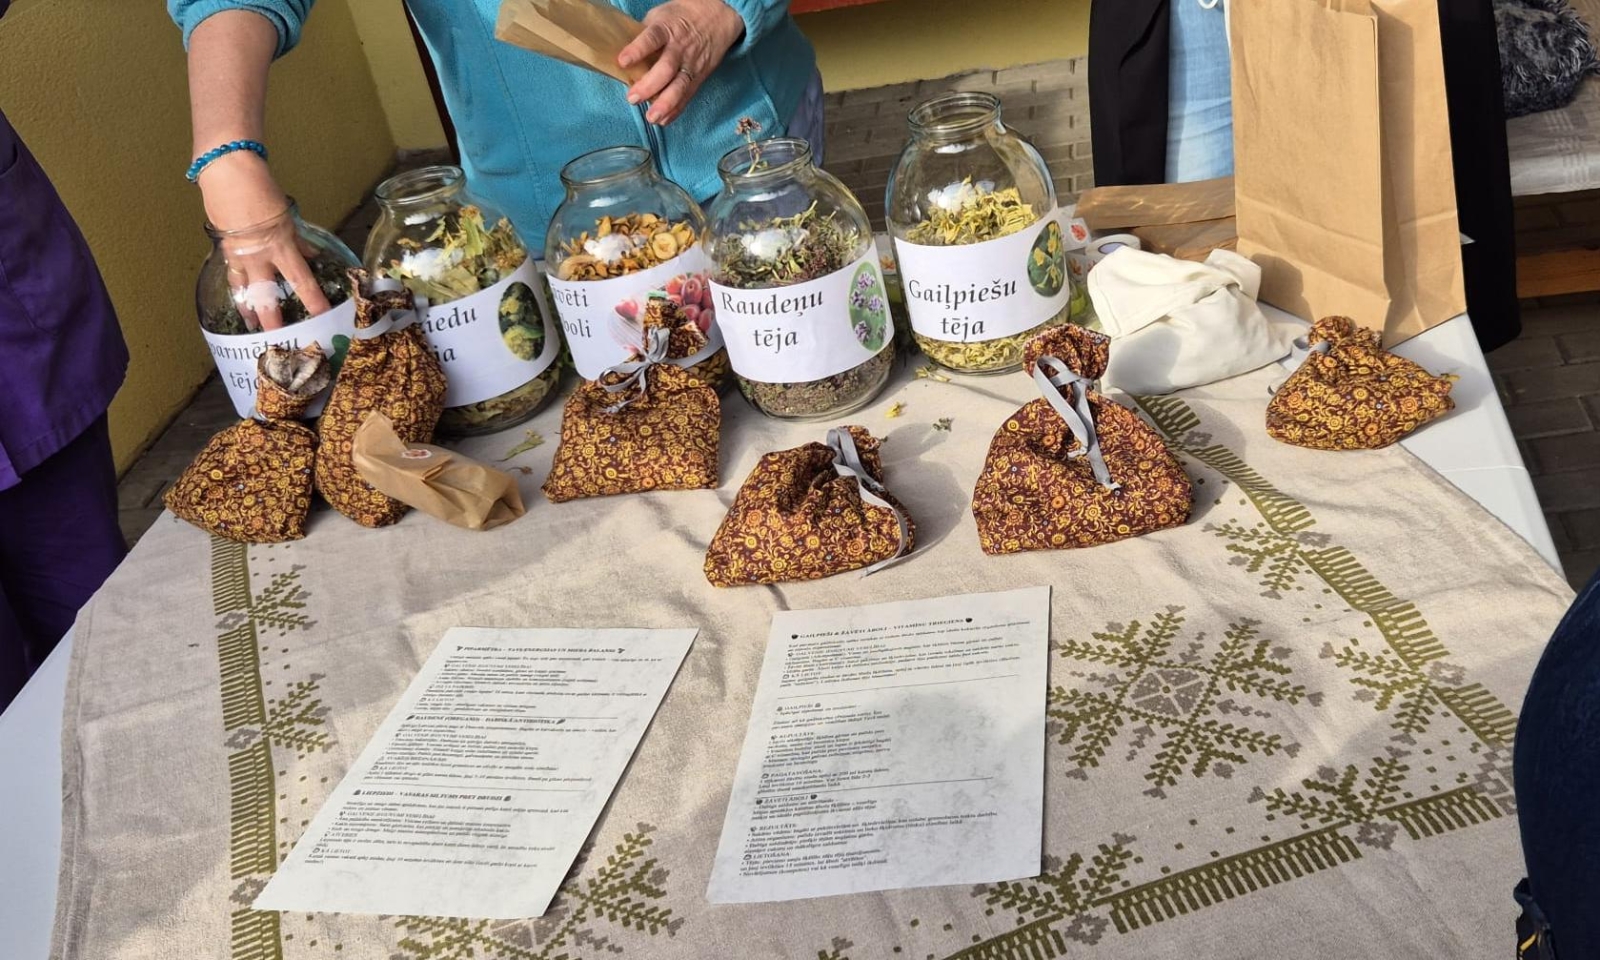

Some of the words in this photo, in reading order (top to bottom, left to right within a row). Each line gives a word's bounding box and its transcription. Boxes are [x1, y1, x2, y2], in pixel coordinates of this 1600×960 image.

[721, 291, 823, 317] Raudeņu
[908, 279, 1017, 310] Gaiļpiešu
[421, 307, 477, 334] iedu
[940, 316, 985, 343] tēja
[210, 338, 300, 360] armētu
[753, 327, 798, 354] tēja
